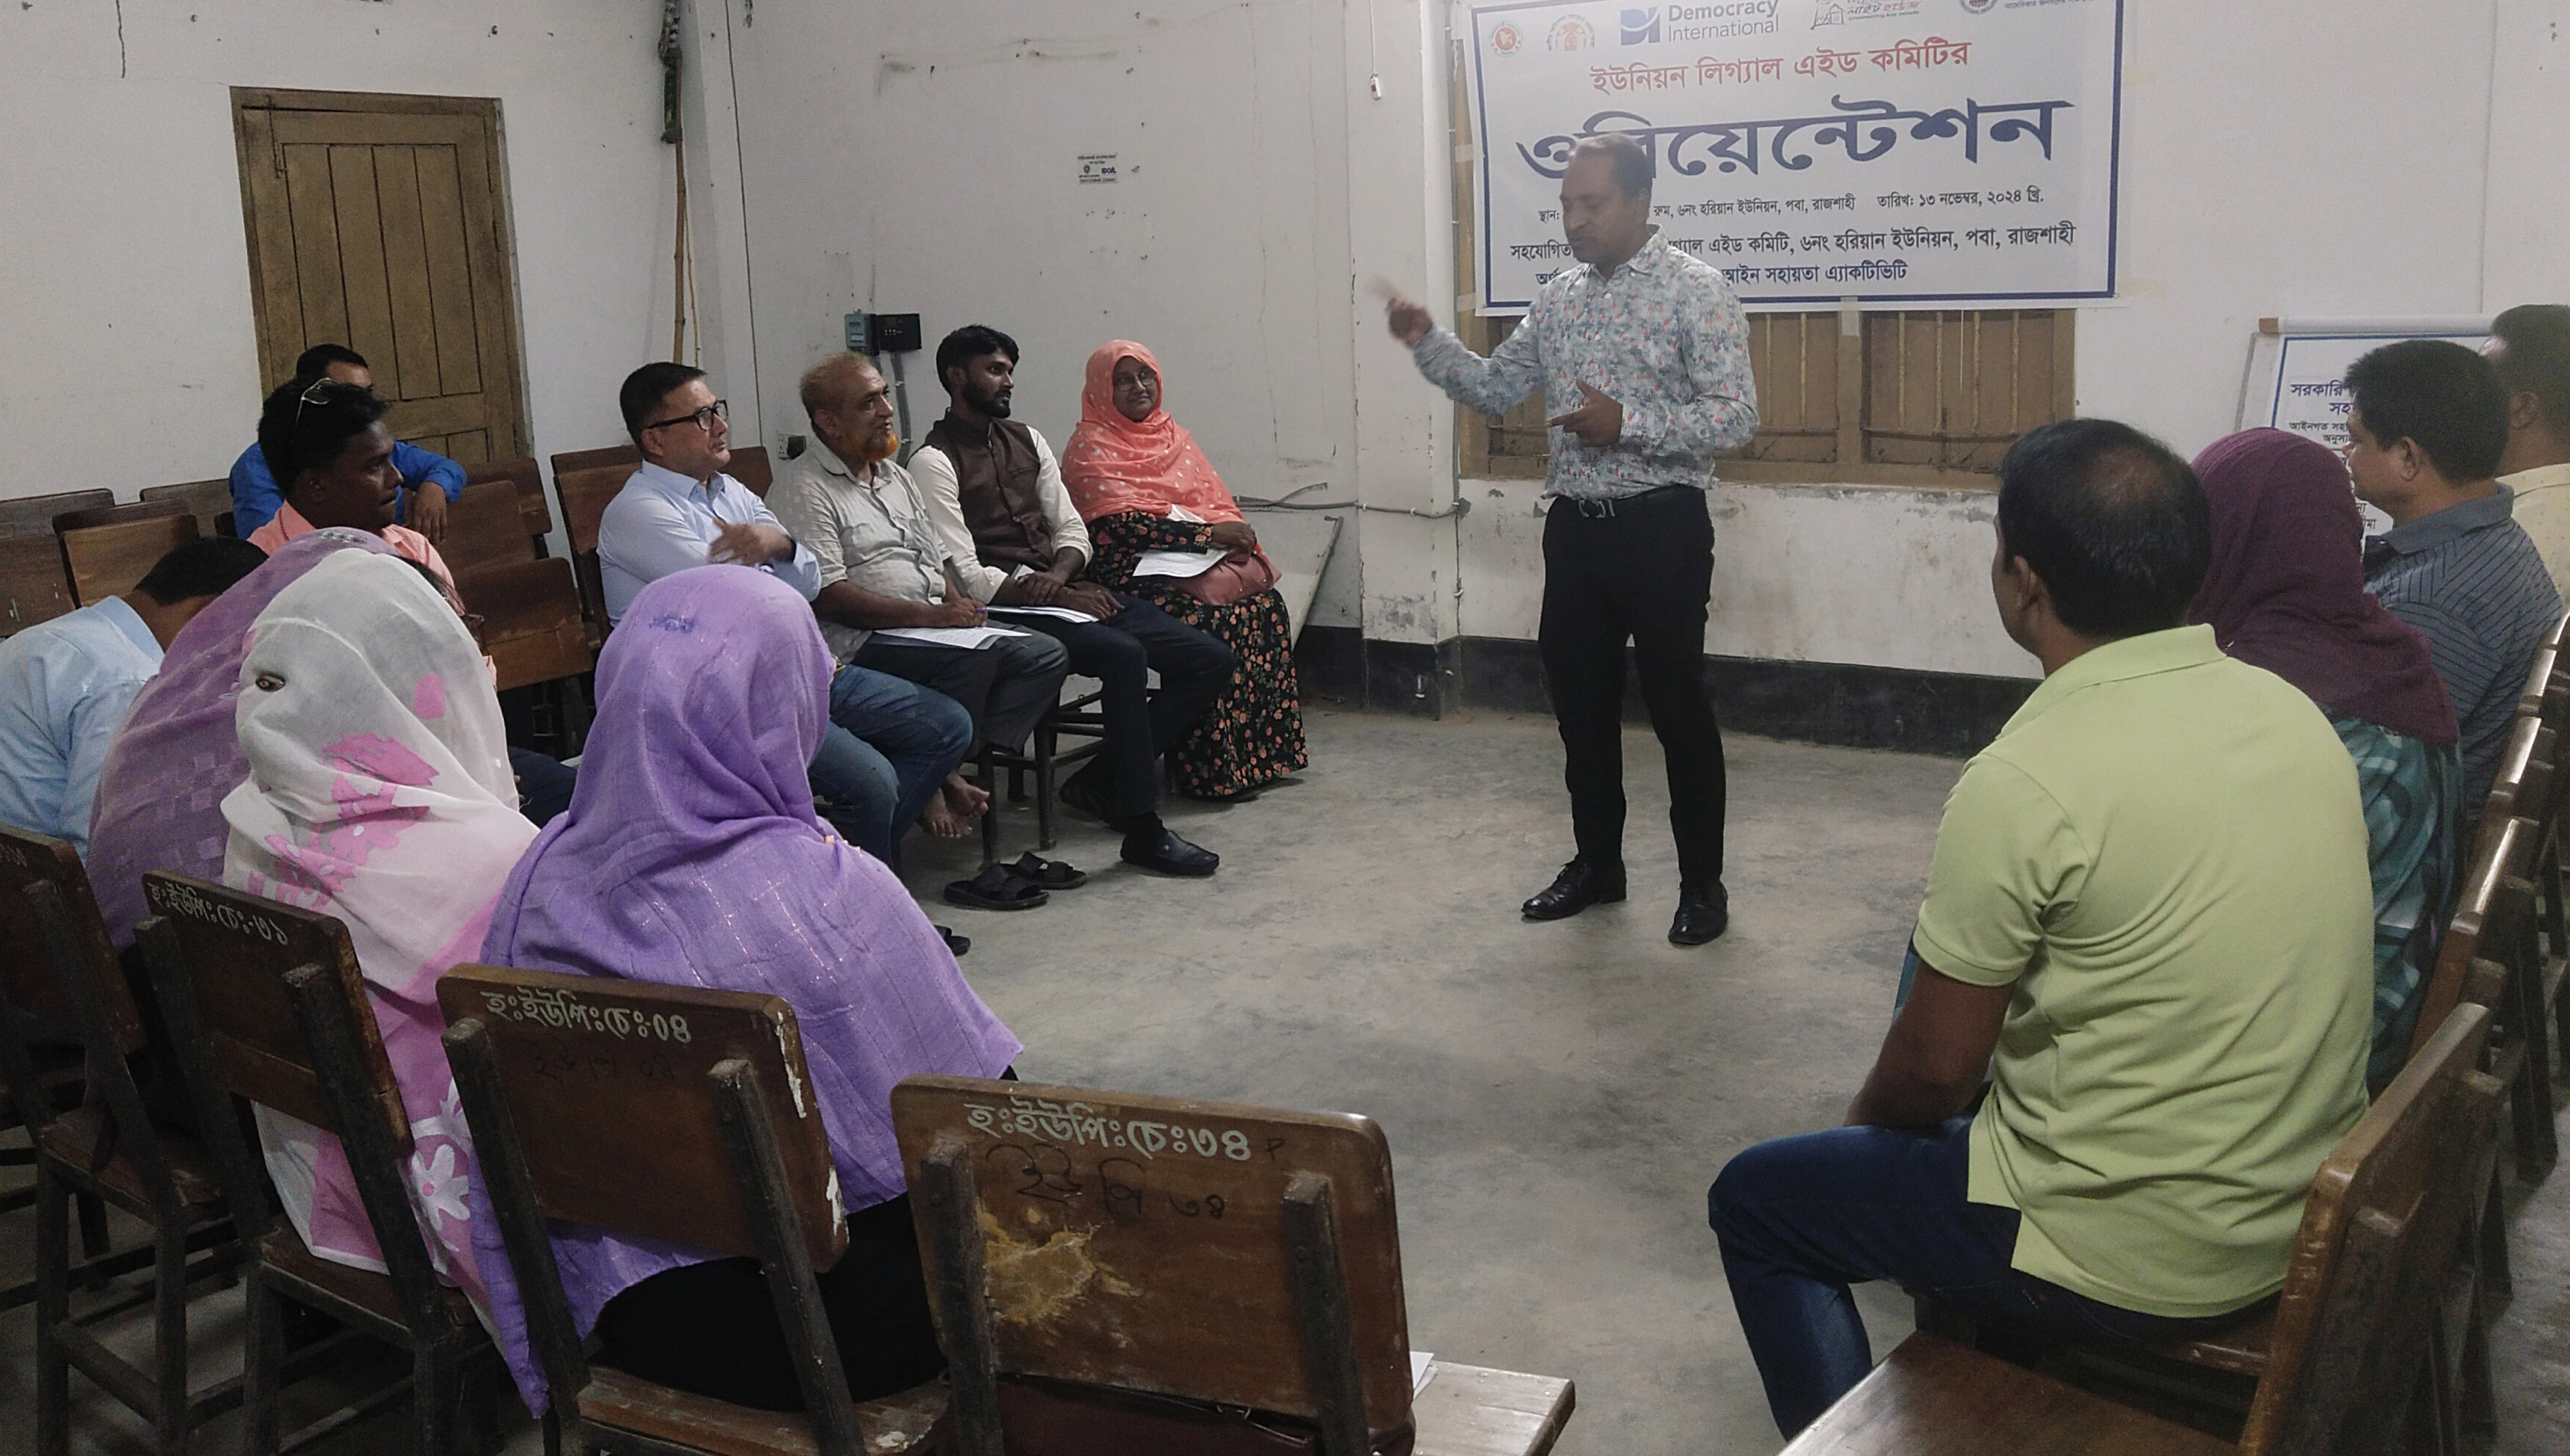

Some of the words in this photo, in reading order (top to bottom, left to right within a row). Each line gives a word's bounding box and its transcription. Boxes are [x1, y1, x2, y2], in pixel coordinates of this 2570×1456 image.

[1668, 0, 1779, 22] Democracy
[1668, 14, 1779, 42] International
[1591, 61, 1688, 95] ইউনিয়ন
[1695, 56, 1784, 86] লিগ্যাল
[1795, 46, 1860, 78] এইড
[1868, 36, 1972, 71] কমিটির
[1678, 204, 1697, 216] ৬নং
[1699, 199, 1734, 216] হরিয়ান
[1737, 198, 1781, 216] ইউনিয়ন,
[1785, 198, 1808, 214] পবা,
[1812, 193, 1856, 211] রাজশাহী
[1919, 193, 1935, 206] ১৩
[1939, 191, 1982, 207] নভেম্বর,
[1987, 190, 2022, 204] ২০২৪
[1510, 239, 1571, 261] সহযোগিত
[1709, 233, 1744, 255] এইড
[1747, 231, 1794, 255] কমিটি,
[1800, 235, 1830, 253] ৬নং
[1835, 229, 1886, 253] হরিয়ান
[1890, 226, 1959, 251] ইউনিয়ন,
[1965, 227, 2001, 250] পবা,
[2007, 221, 2077, 246] রাজশাহী
[1765, 265, 1820, 285] সহায়তা
[2290, 379, 2342, 397] সরকারি
